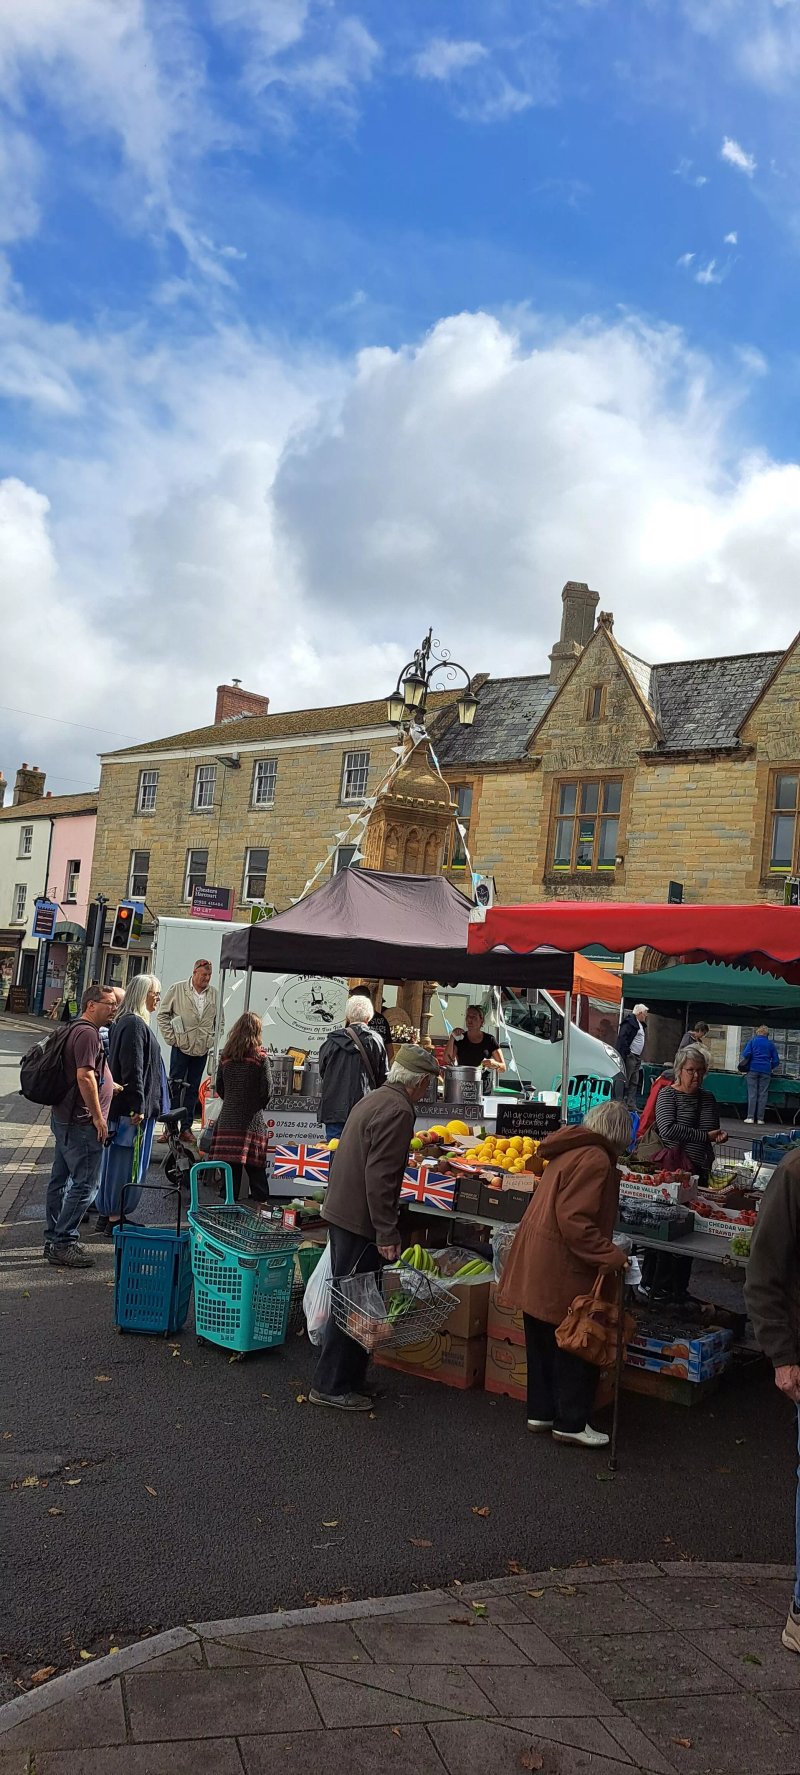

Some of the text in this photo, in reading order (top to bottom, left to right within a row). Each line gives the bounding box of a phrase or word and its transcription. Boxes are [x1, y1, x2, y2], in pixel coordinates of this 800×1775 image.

[620, 1182, 661, 1194] HEDDAR VALLEY
[708, 1222, 736, 1231] CHEDDAR
